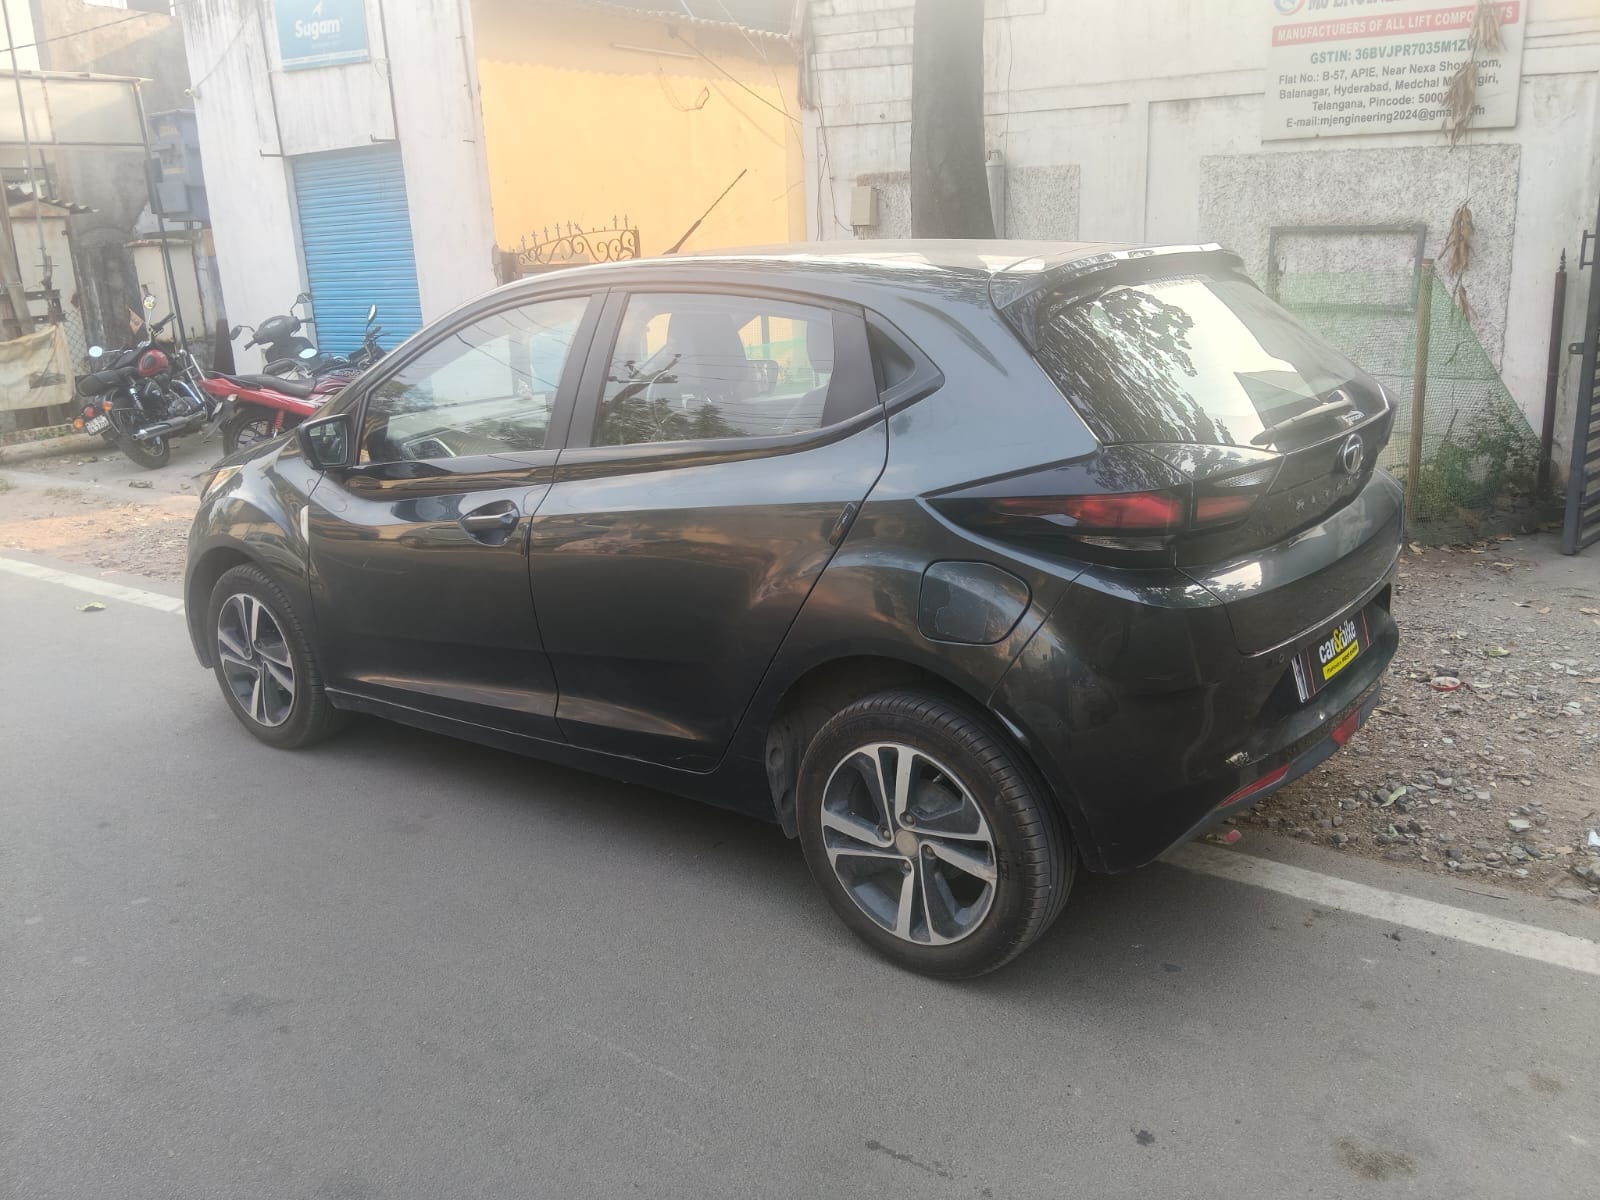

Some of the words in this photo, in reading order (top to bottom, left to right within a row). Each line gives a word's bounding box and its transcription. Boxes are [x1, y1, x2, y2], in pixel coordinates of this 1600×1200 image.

[295, 19, 340, 40] Sugam
[1278, 21, 1366, 41] MANUFACTURERS
[1369, 19, 1382, 32] OF
[1385, 17, 1405, 31] ALL
[1408, 14, 1433, 29] LIFT
[1310, 49, 1352, 65] GSTIN:
[1279, 74, 1297, 85] Flat
[1322, 69, 1348, 81] B-57,
[1382, 65, 1407, 76] Near
[1409, 63, 1436, 74] Nexa
[1279, 86, 1331, 99] Balanagar,
[1333, 81, 1392, 97] Hyderabad,
[1395, 76, 1439, 90] Medchal
[1312, 100, 1366, 112] Telangana,
[1369, 94, 1415, 108] Pincode:
[1318, 619, 1357, 664] car&bike
